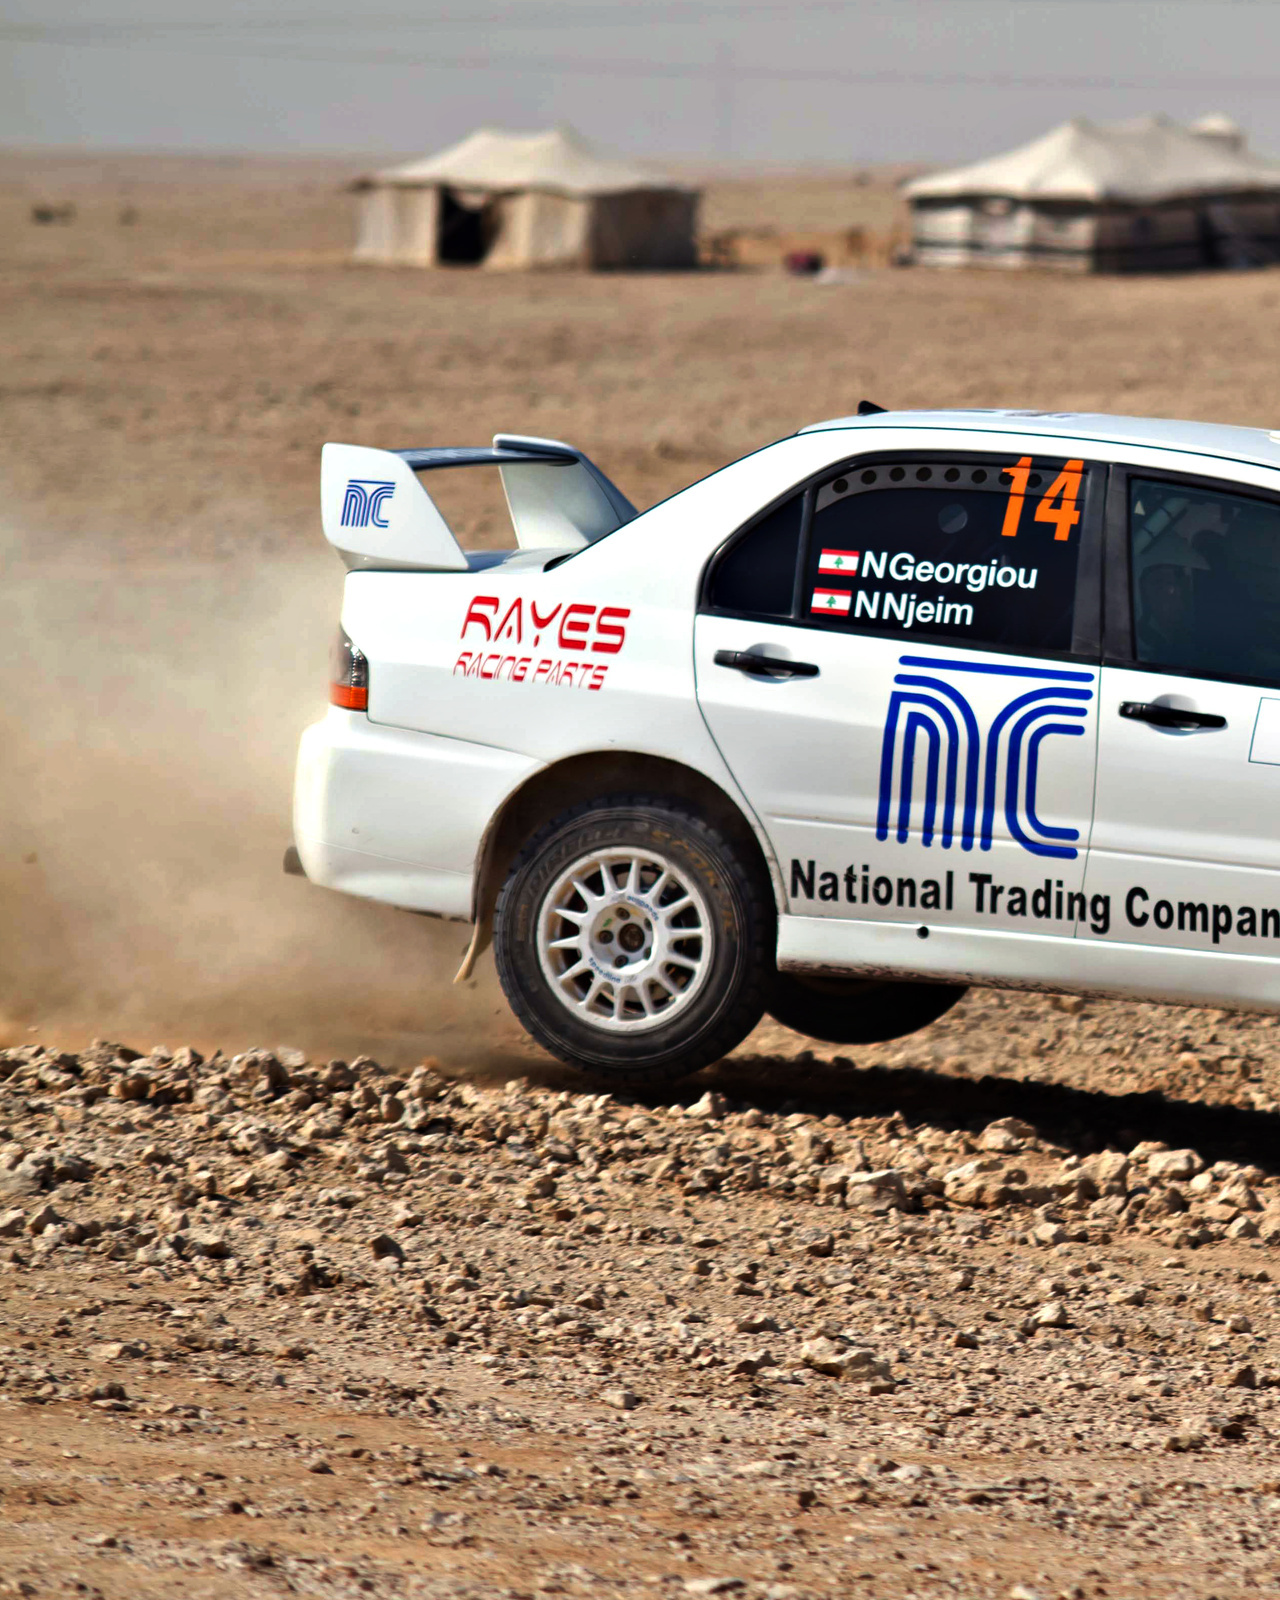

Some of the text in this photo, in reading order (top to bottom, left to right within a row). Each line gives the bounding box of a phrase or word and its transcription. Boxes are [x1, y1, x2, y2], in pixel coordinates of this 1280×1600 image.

[1001, 457, 1084, 541] 14
[460, 595, 632, 654] RAYES
[453, 651, 608, 691] RACING PARTS
[790, 859, 954, 911] National
[968, 873, 1111, 934] Trading
